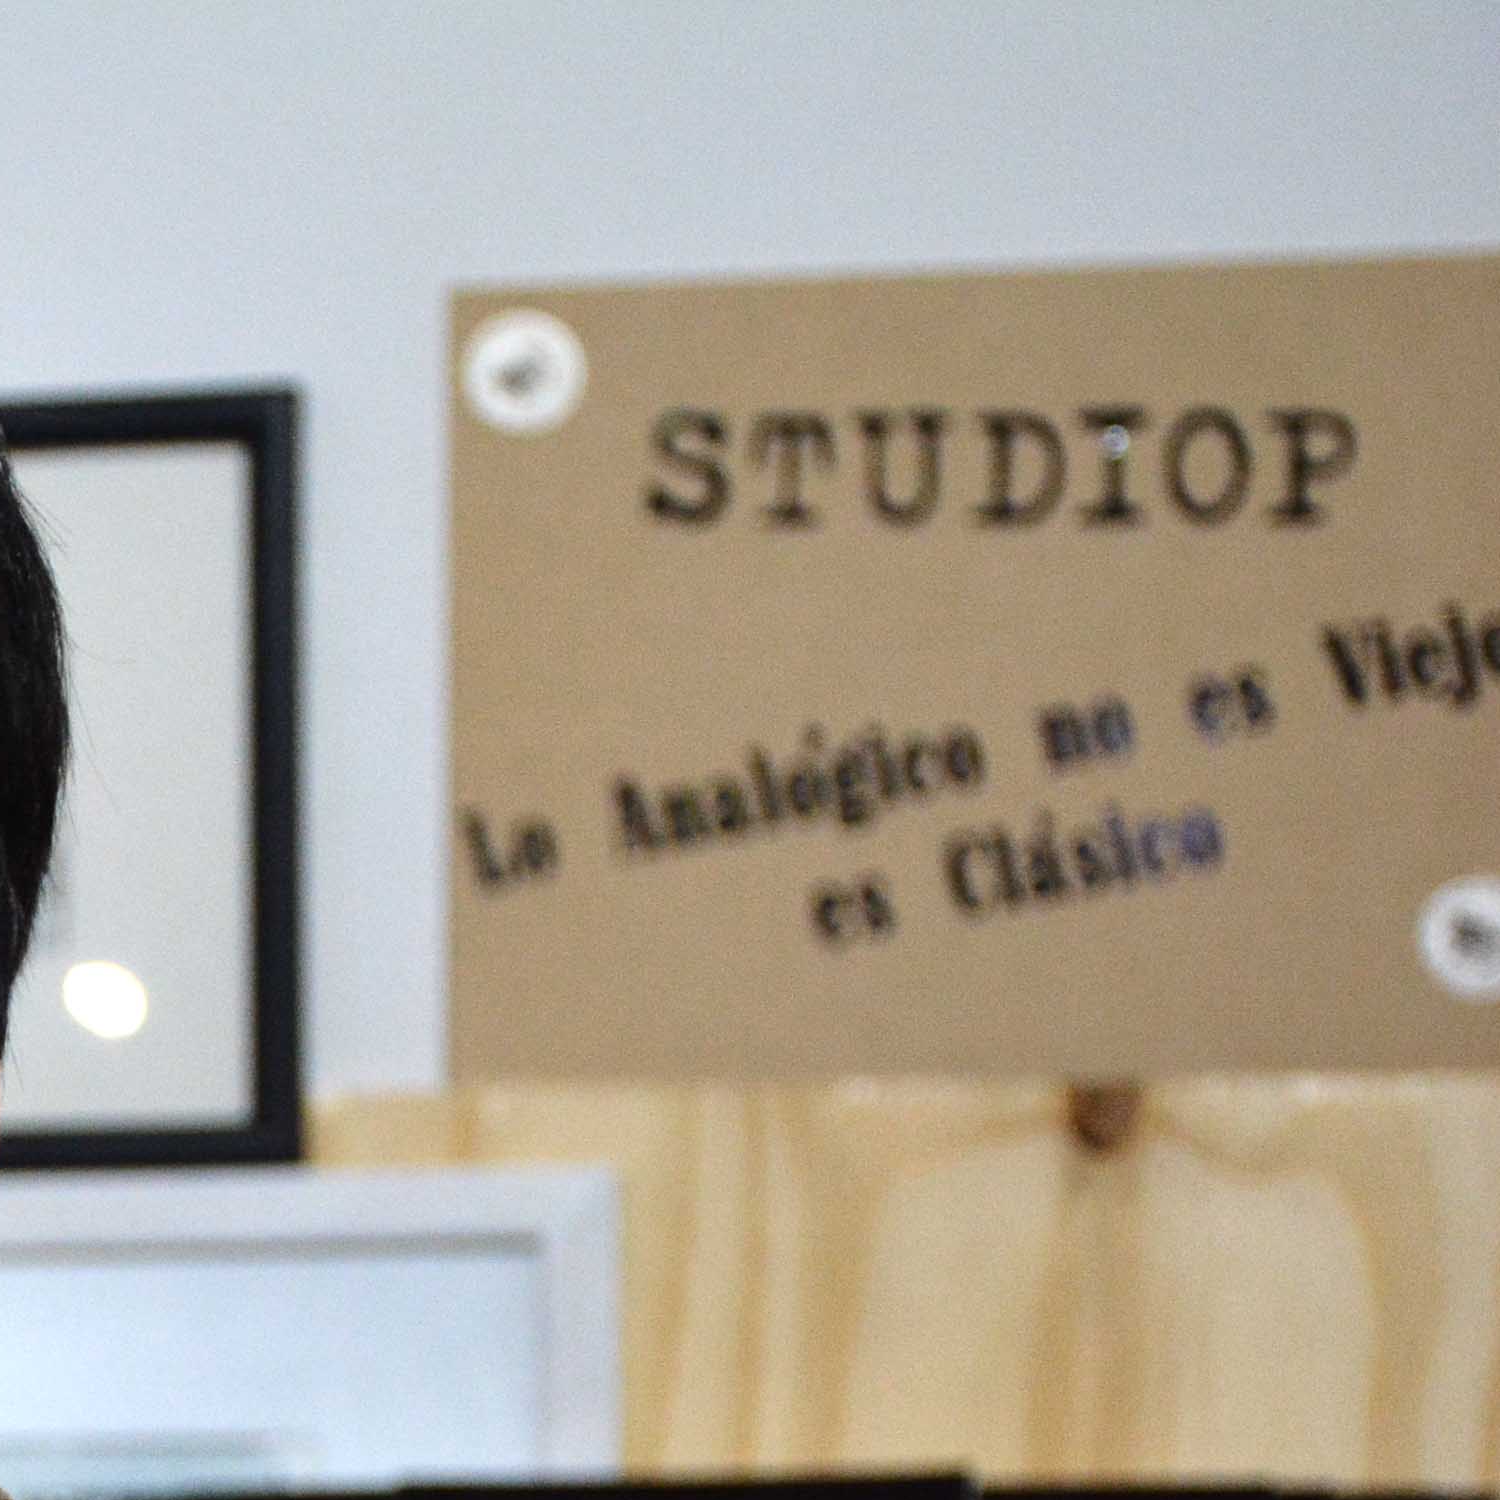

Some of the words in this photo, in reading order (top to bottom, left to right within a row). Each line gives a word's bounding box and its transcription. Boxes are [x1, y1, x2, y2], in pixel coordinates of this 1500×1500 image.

[644, 406, 1357, 529] STUDIOP
[464, 806, 558, 890] Lo
[611, 726, 985, 858] Analógico
[1038, 698, 1134, 774] no
[1191, 664, 1278, 740] es
[812, 876, 891, 940] es
[946, 808, 1222, 912] Clásico
